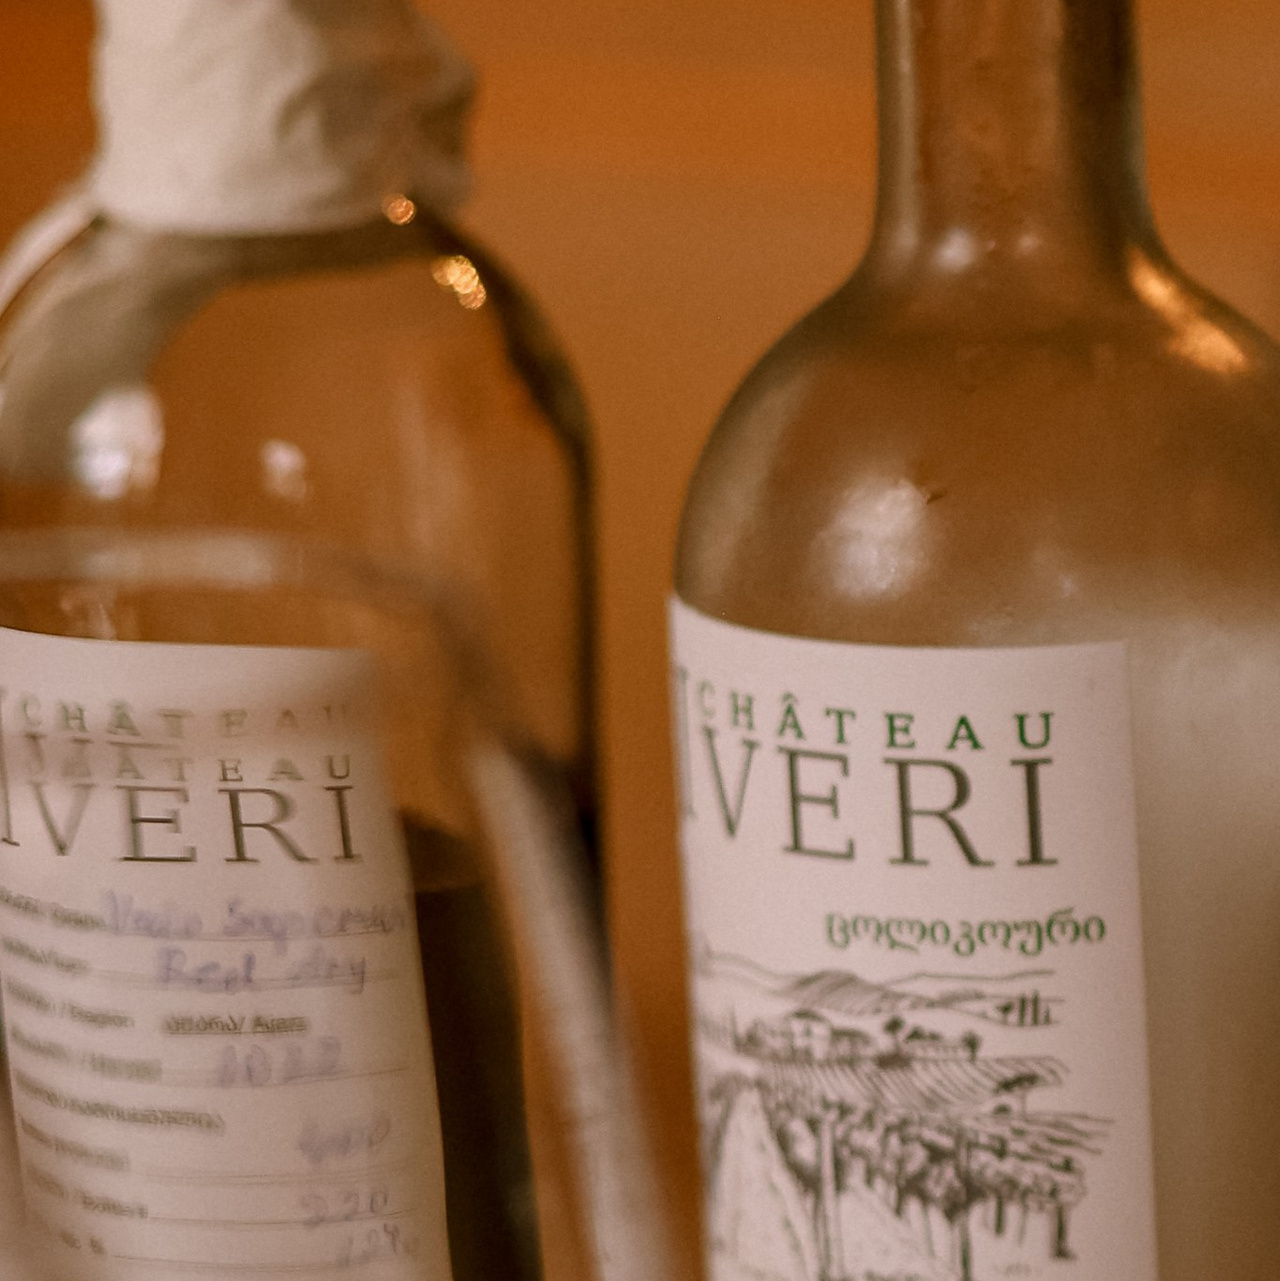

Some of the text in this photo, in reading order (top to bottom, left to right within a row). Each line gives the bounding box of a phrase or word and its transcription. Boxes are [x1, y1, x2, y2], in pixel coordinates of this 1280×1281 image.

[699, 680, 1053, 751] CHÂTEAU
[676, 666, 1060, 867] IVERI
[825, 907, 1107, 956] ცოლიკოური
